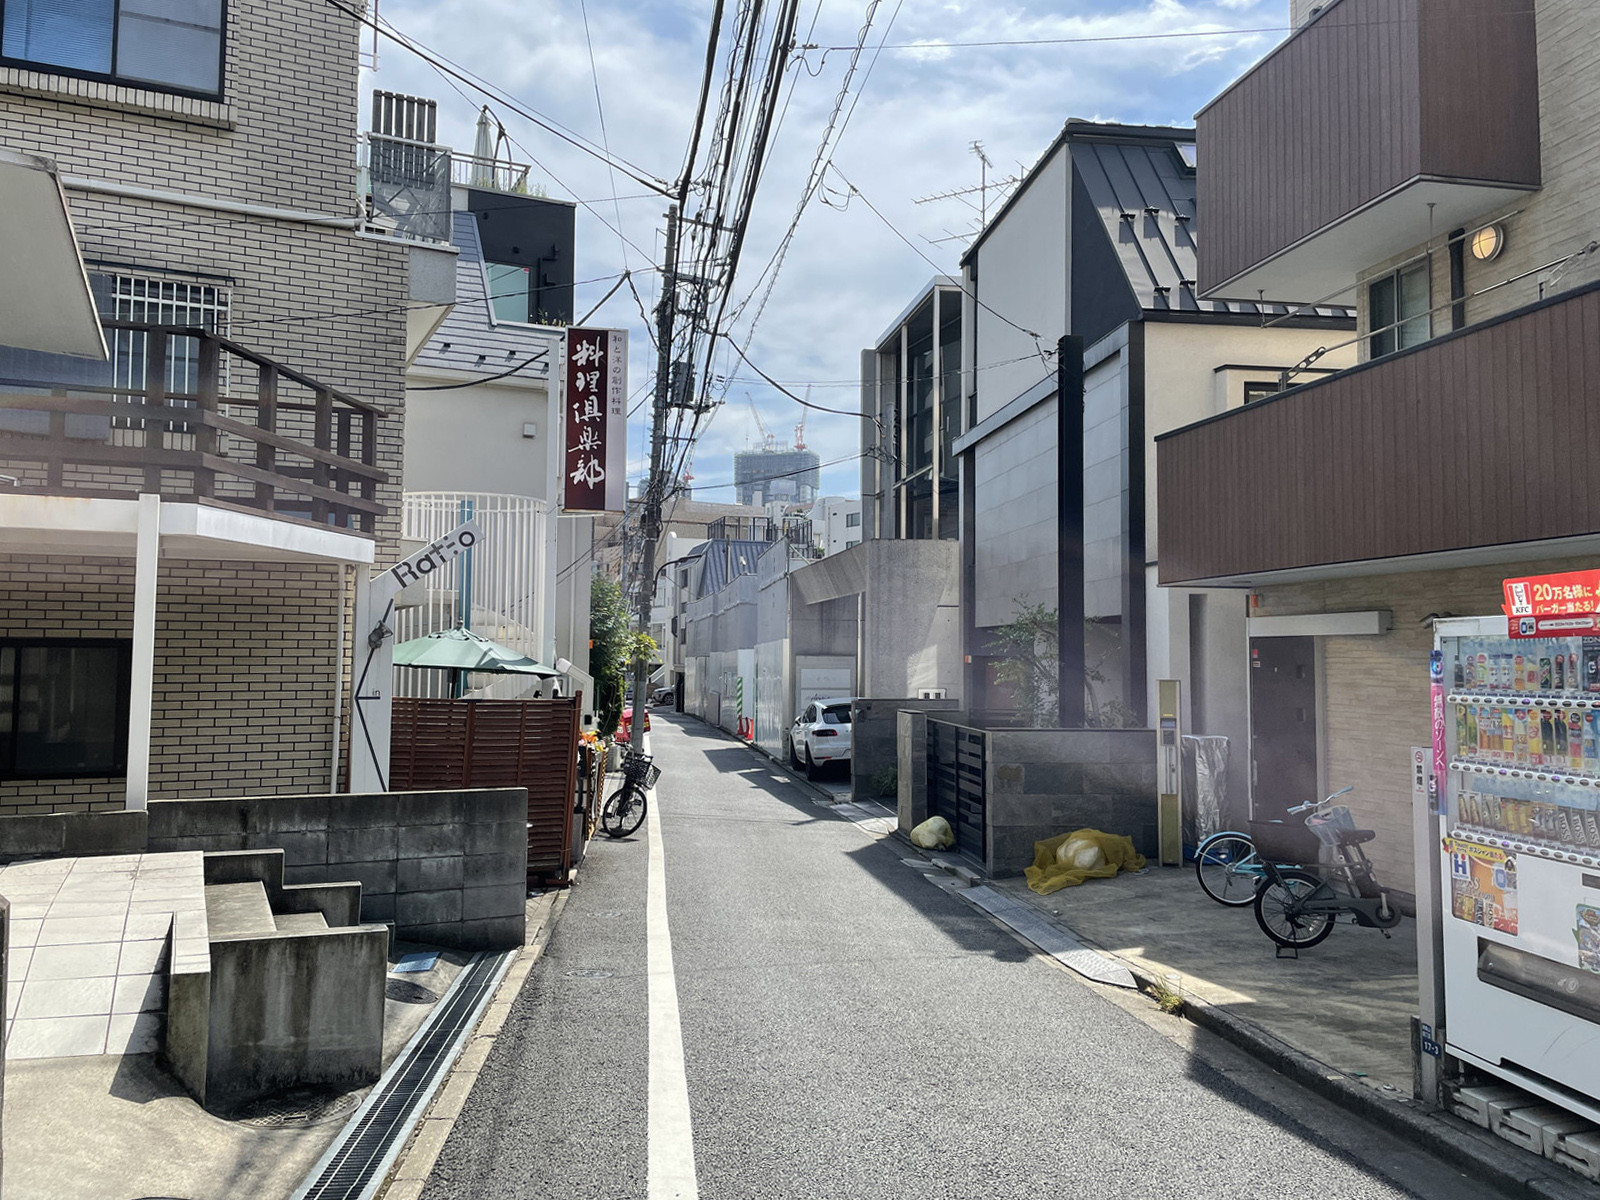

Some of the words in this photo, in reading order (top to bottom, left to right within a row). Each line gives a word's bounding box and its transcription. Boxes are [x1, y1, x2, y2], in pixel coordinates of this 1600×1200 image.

[611, 335, 622, 416] 和と洋の創作料理
[568, 335, 605, 490] 料理倶楽部
[1533, 583, 1593, 601] 20万名様に
[372, 688, 381, 696] in
[1559, 813, 1571, 841] BOSS
[1573, 815, 1586, 844] BOSS
[1587, 817, 1600, 847] BOSS
